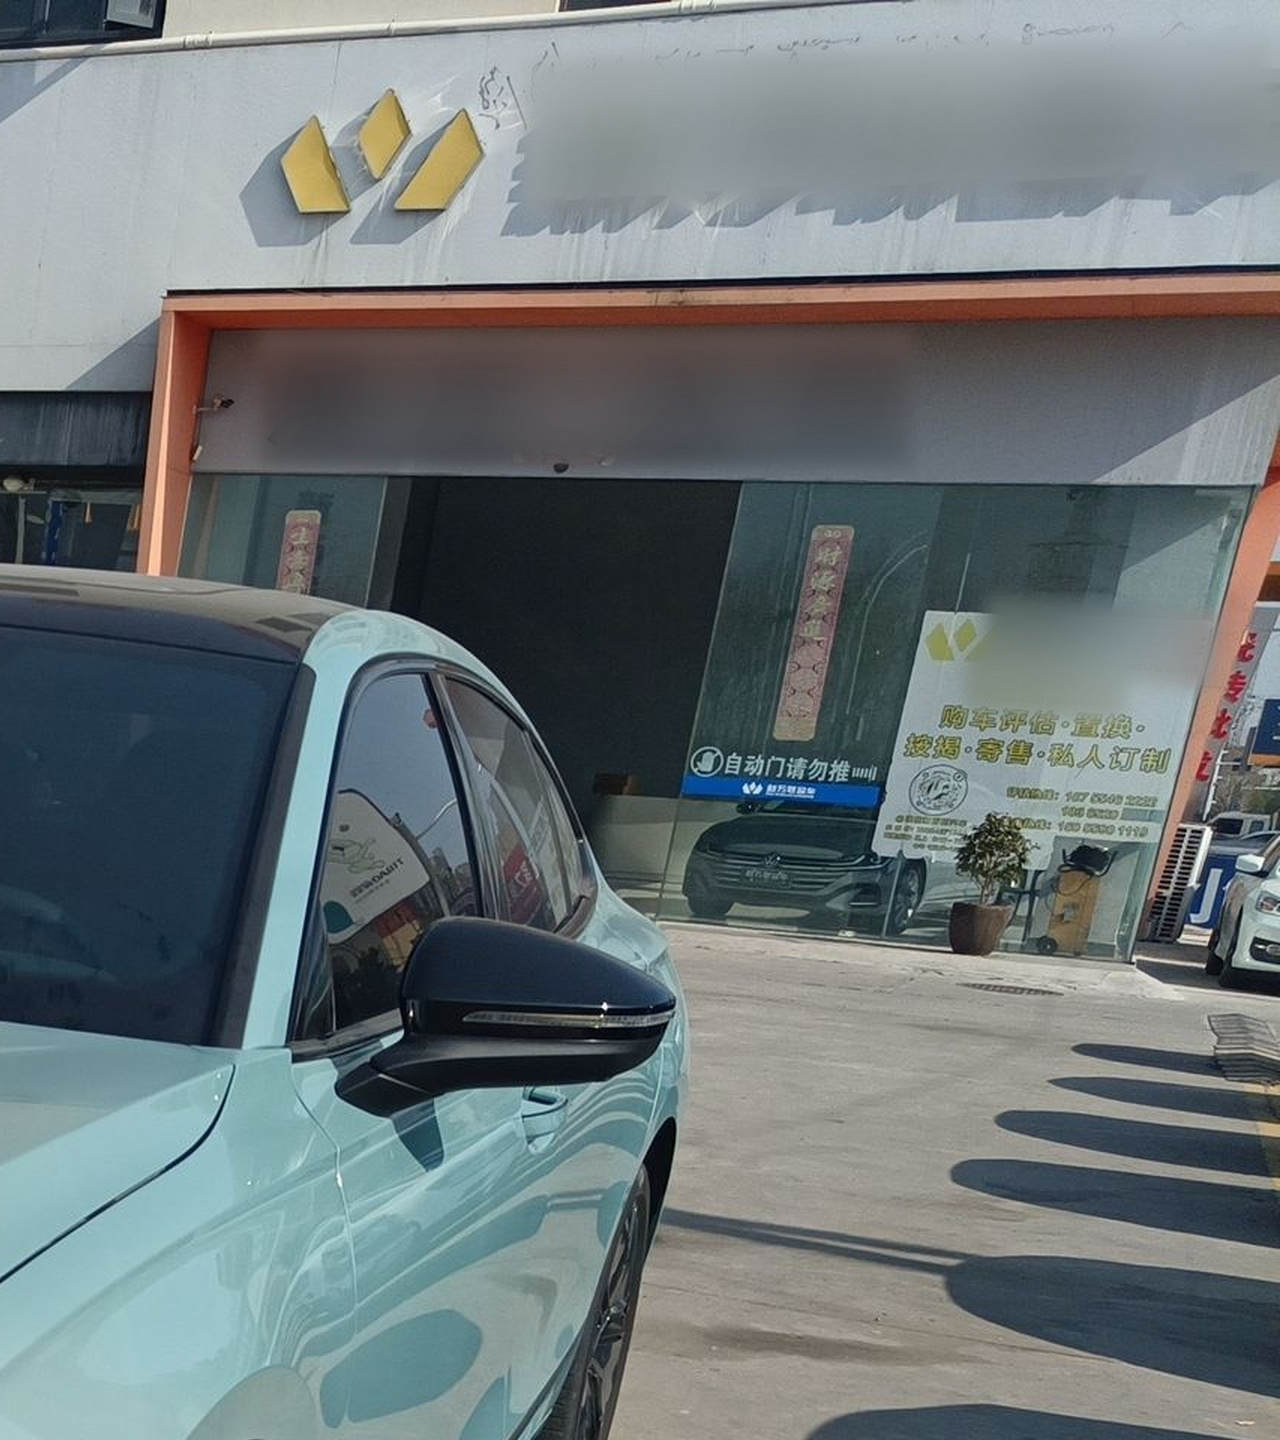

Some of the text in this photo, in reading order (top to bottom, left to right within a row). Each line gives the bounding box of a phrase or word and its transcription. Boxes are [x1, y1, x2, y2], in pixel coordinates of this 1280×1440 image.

[724, 752, 851, 782] 自动门请勿推
